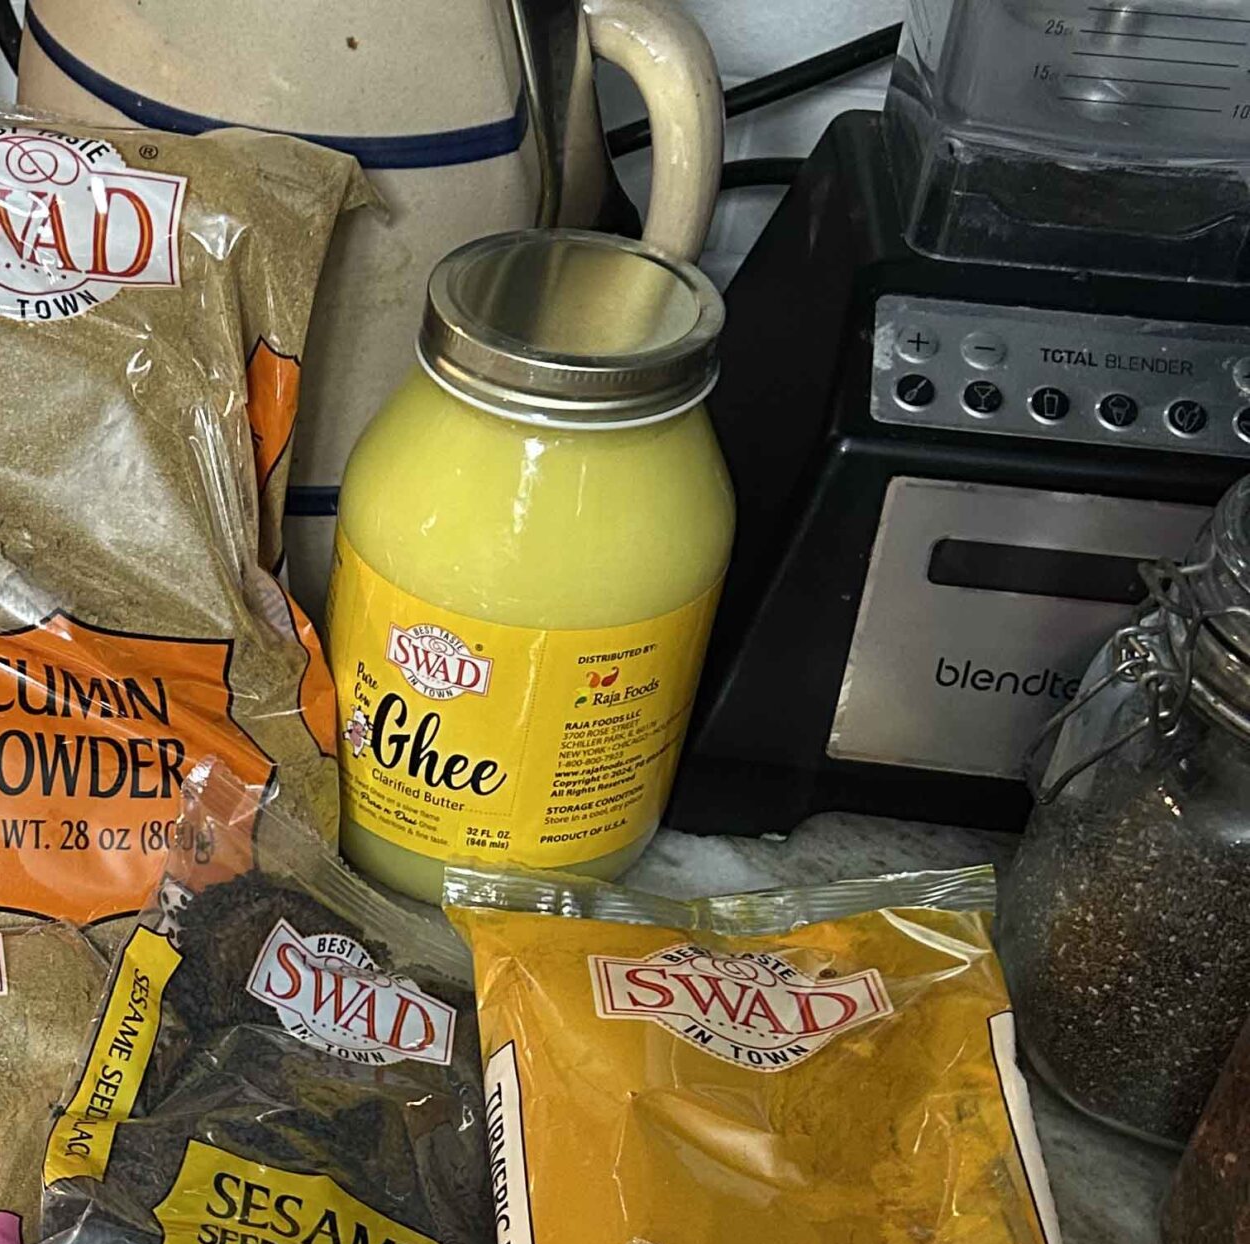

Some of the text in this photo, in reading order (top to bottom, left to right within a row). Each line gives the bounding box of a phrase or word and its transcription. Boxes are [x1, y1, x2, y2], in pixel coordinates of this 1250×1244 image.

[16, 290, 100, 320] TOWN
[1039, 347, 1194, 376] TOTAL BLENDER
[413, 626, 434, 637] BEST
[393, 634, 482, 689] SWAD
[578, 648, 642, 665] DISTRIBUTED
[422, 686, 455, 699] TOWN
[592, 678, 660, 708] Raja Foods
[565, 722, 590, 731] RAJA
[592, 714, 625, 729] FOODS
[370, 692, 508, 797] Ghee
[371, 768, 421, 800] Clarified
[423, 790, 466, 812] Butter
[553, 772, 601, 788] Copyright
[2, 819, 51, 851] WT.
[60, 818, 89, 851] 28
[99, 827, 131, 851] oz
[466, 827, 478, 837] 32
[540, 830, 588, 844] PRODUCT
[316, 937, 354, 959] BEST
[264, 942, 437, 1053] SWAD
[625, 967, 859, 1036] SWAD
[108, 967, 151, 1063] SESAME
[290, 1022, 387, 1064] IN TOWN
[684, 1023, 810, 1066] IN TOWN
